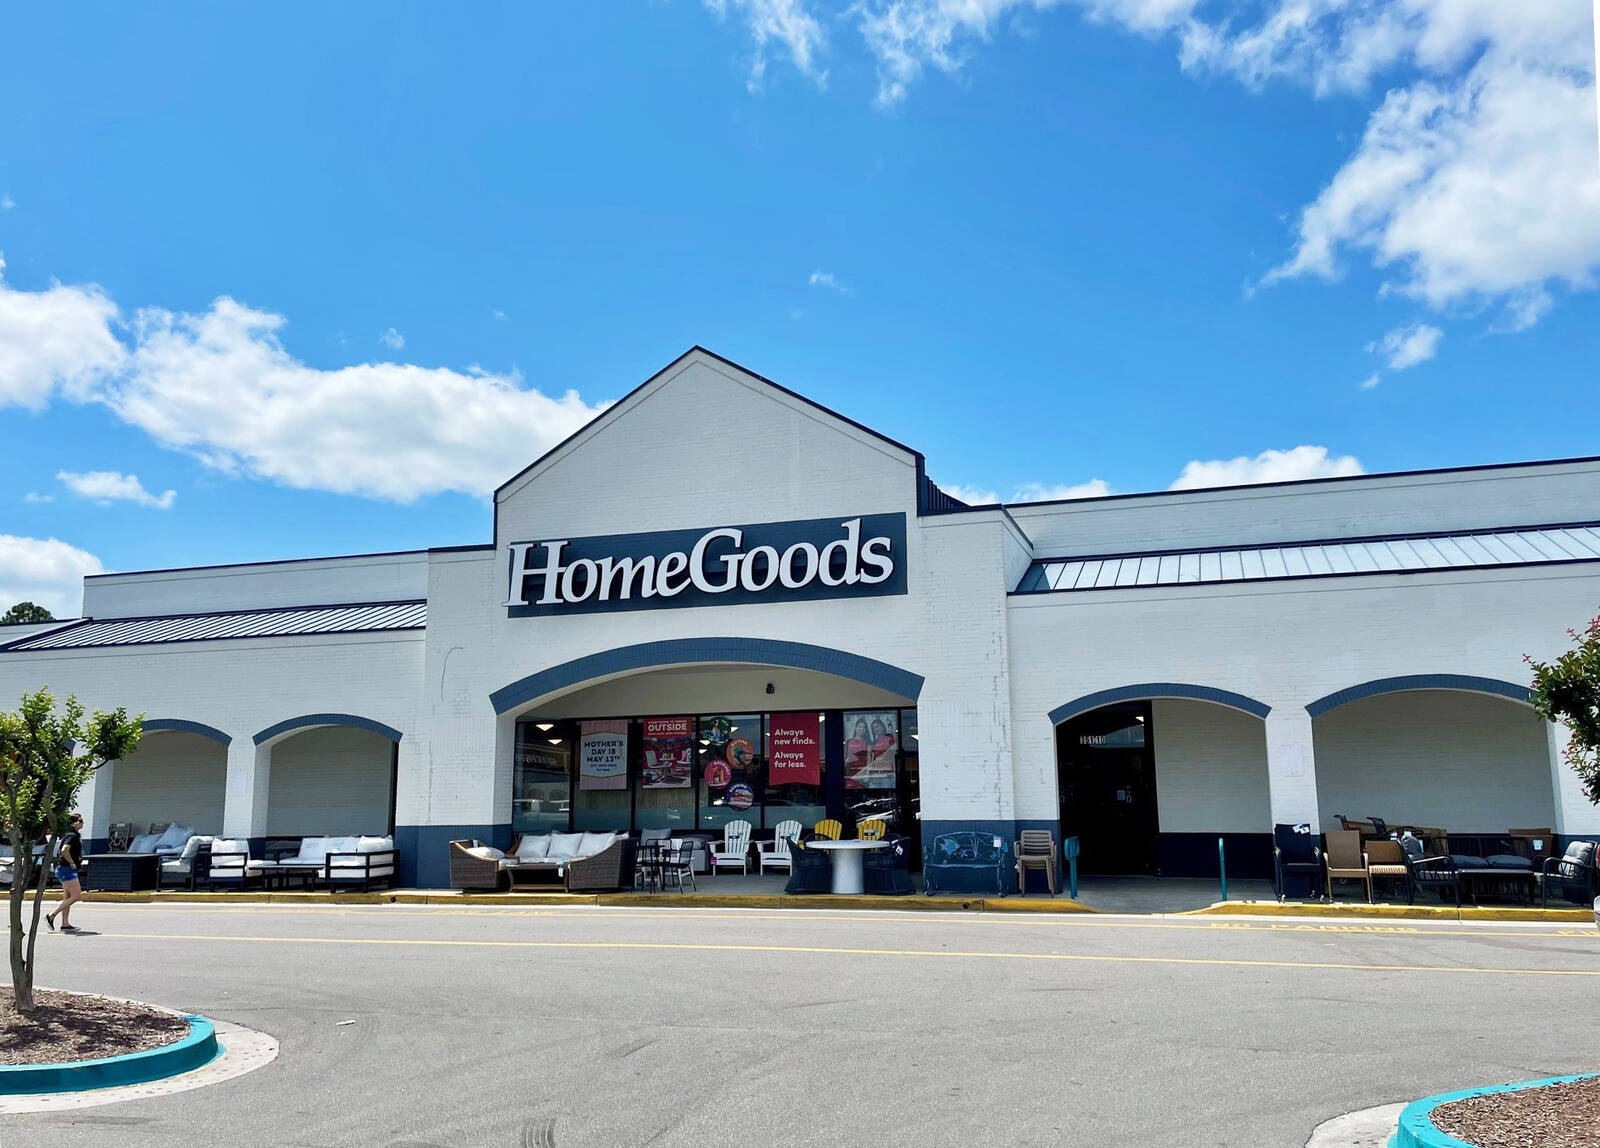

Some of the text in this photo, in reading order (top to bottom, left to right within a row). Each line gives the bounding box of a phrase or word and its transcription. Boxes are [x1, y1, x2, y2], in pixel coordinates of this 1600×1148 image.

[502, 518, 894, 607] HomeGoods
[648, 723, 687, 732] OUTSIDE
[774, 728, 804, 738] Always
[584, 740, 624, 748] MOTHER'S
[792, 737, 815, 745] finds.
[774, 751, 804, 761] Always
[774, 760, 807, 768] for less.
